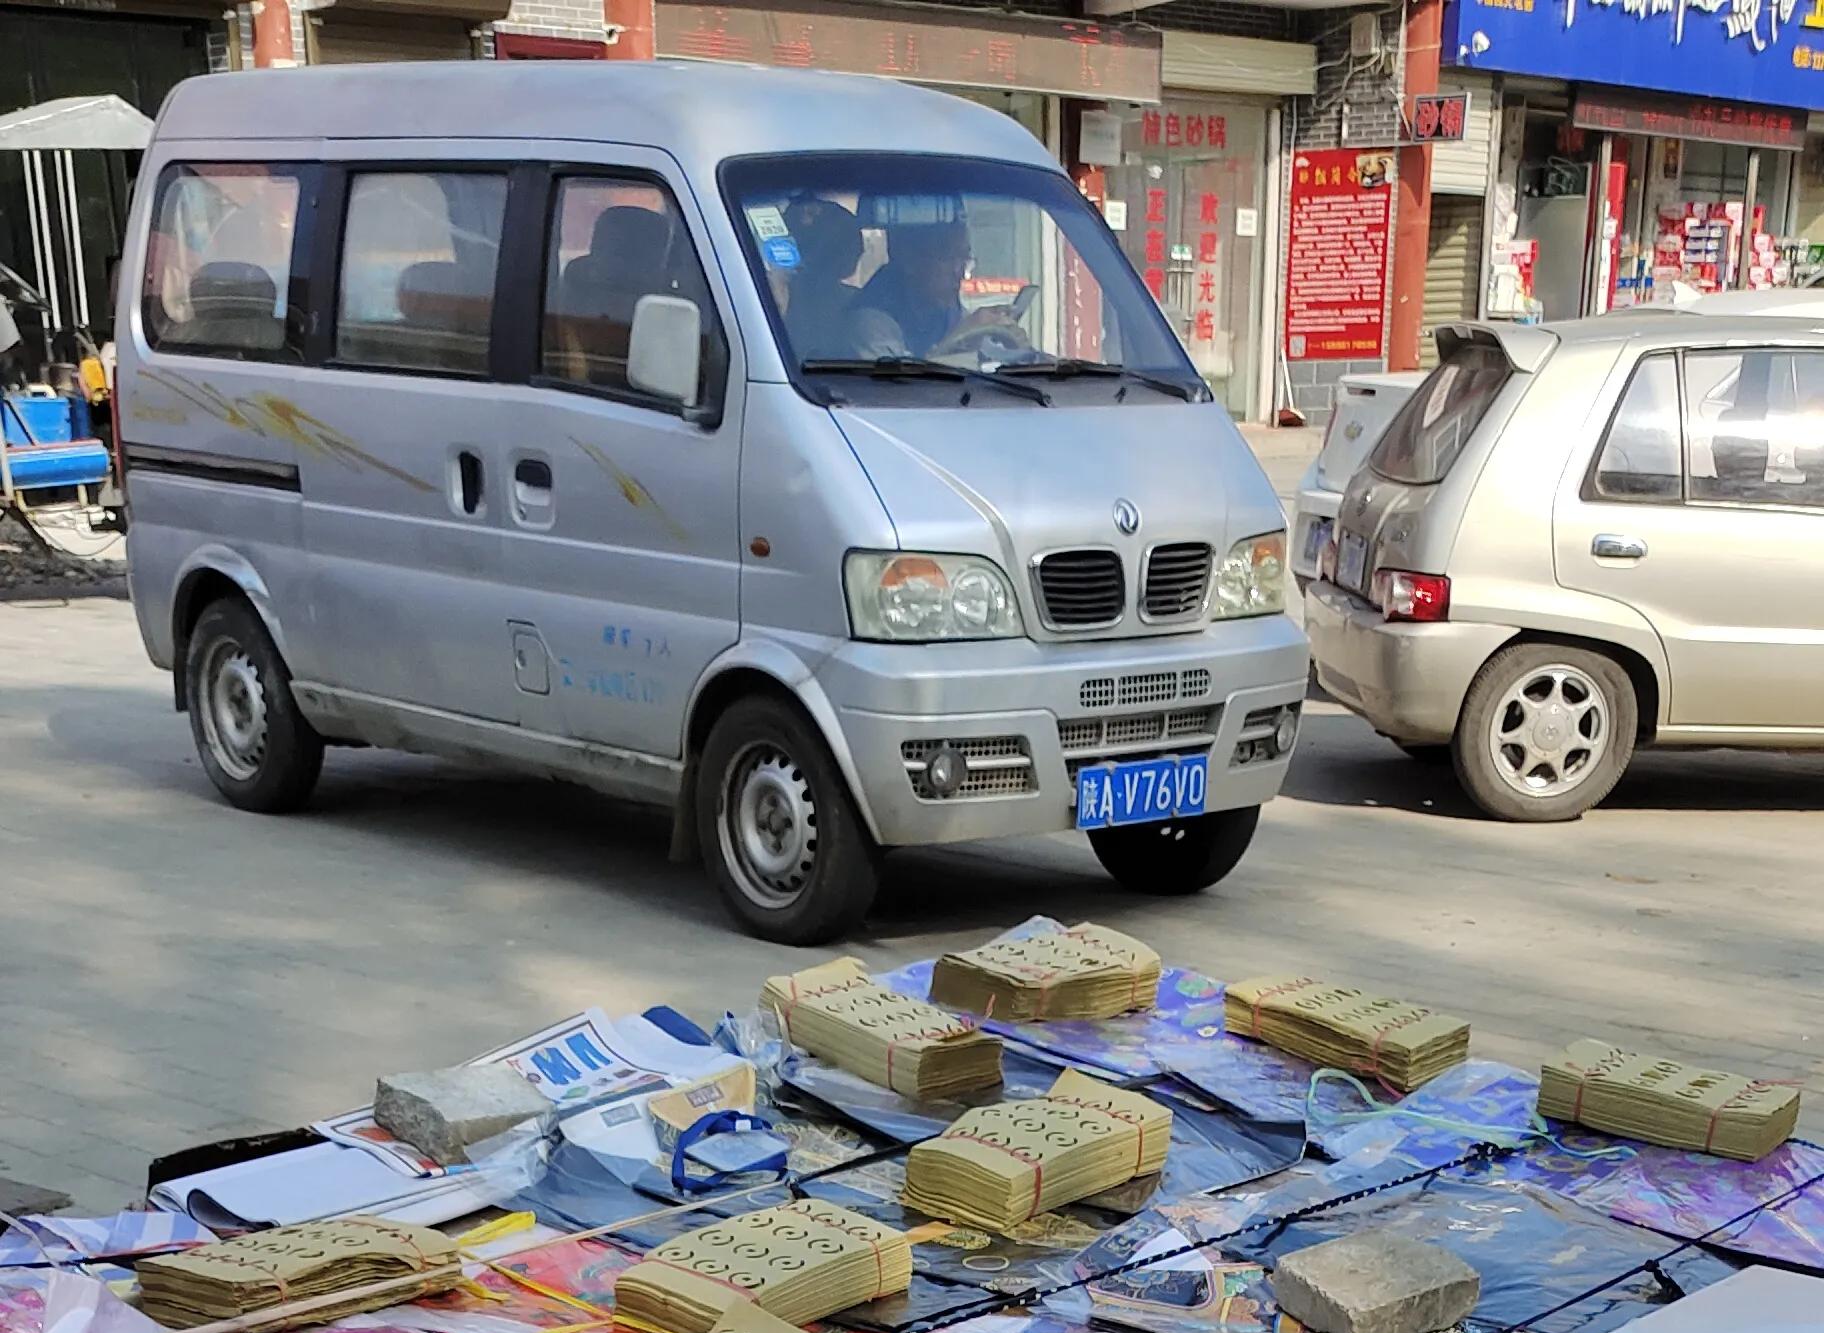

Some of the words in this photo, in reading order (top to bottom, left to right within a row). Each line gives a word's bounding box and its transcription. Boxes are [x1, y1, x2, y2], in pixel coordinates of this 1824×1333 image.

[1142, 110, 1227, 149] 特色砂锅
[1415, 99, 1464, 139] 砂锅
